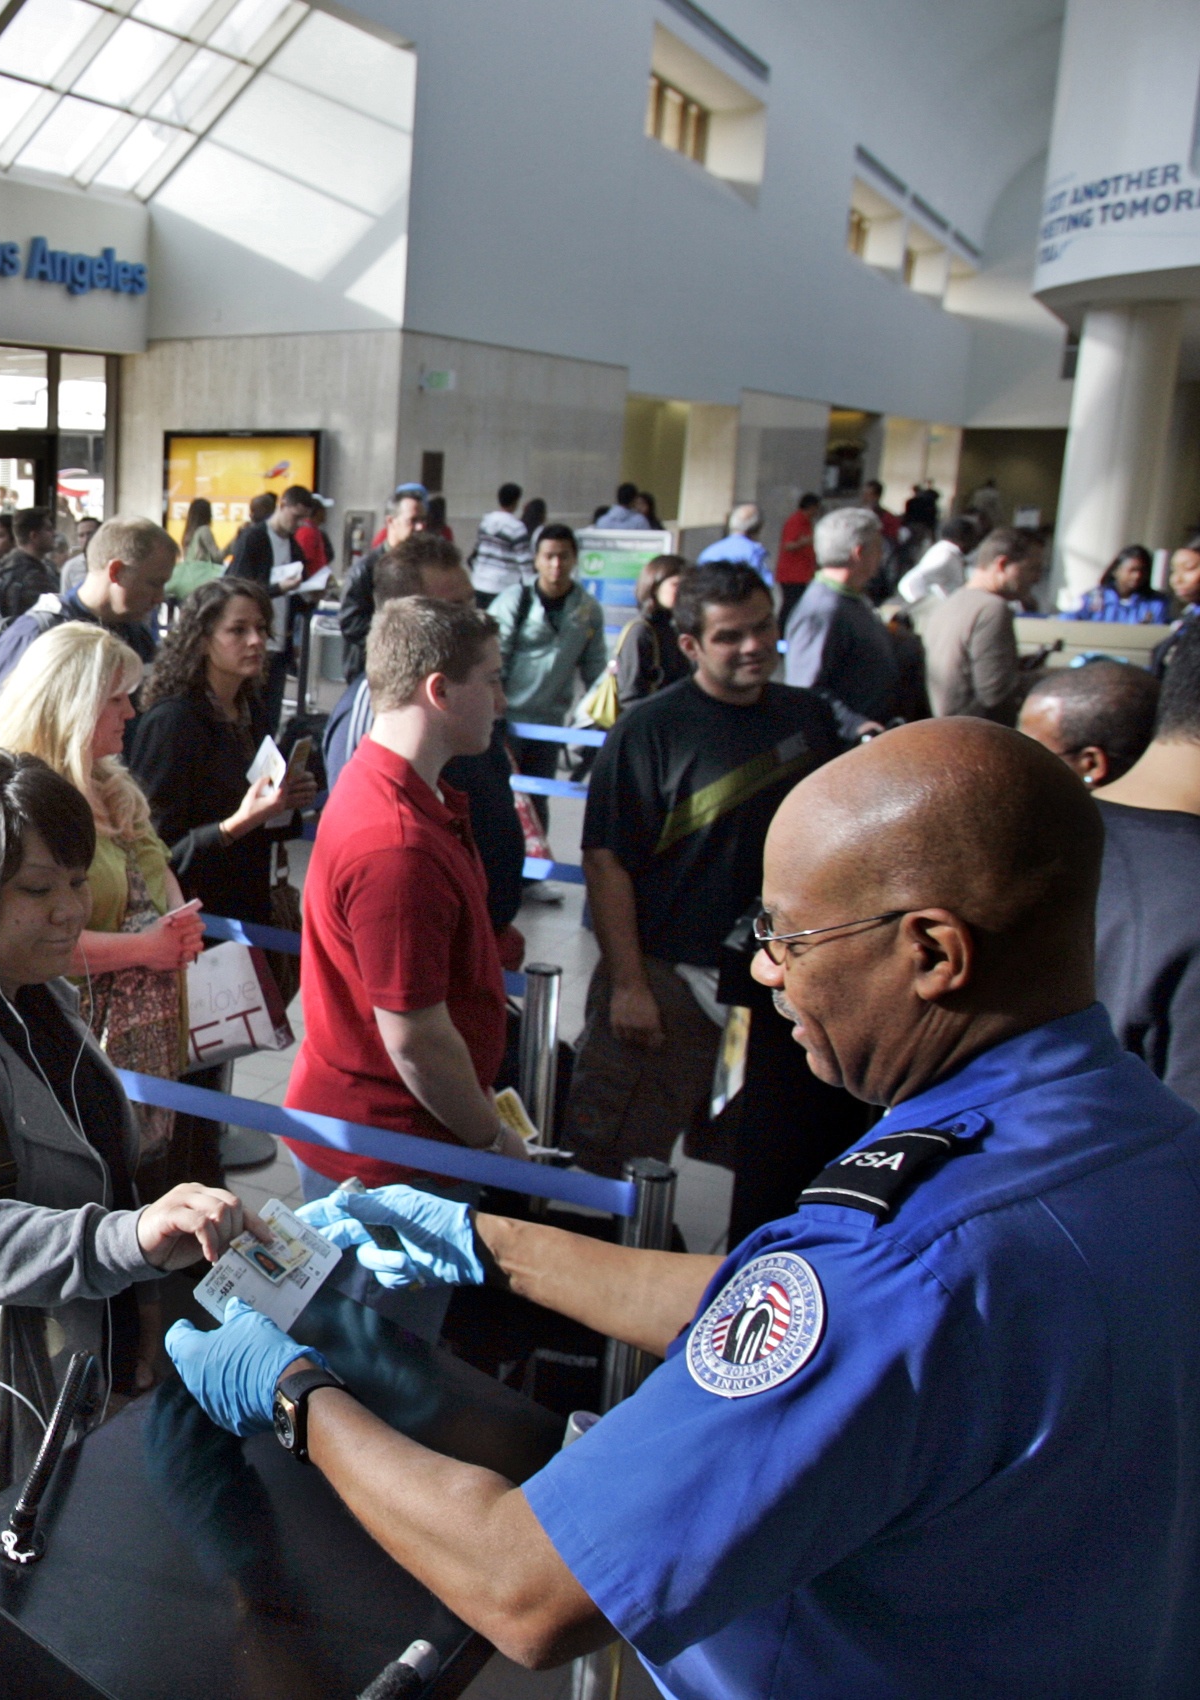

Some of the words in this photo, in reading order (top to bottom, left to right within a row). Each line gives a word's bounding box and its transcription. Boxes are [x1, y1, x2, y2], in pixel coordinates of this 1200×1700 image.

[1069, 163, 1181, 205] ANOTHER
[25, 236, 148, 296] Angeles
[206, 979, 257, 1014] love
[840, 1151, 905, 1171] TSA
[787, 1262, 817, 1314] SPIRIT
[714, 1332, 811, 1391] INNOVATION
